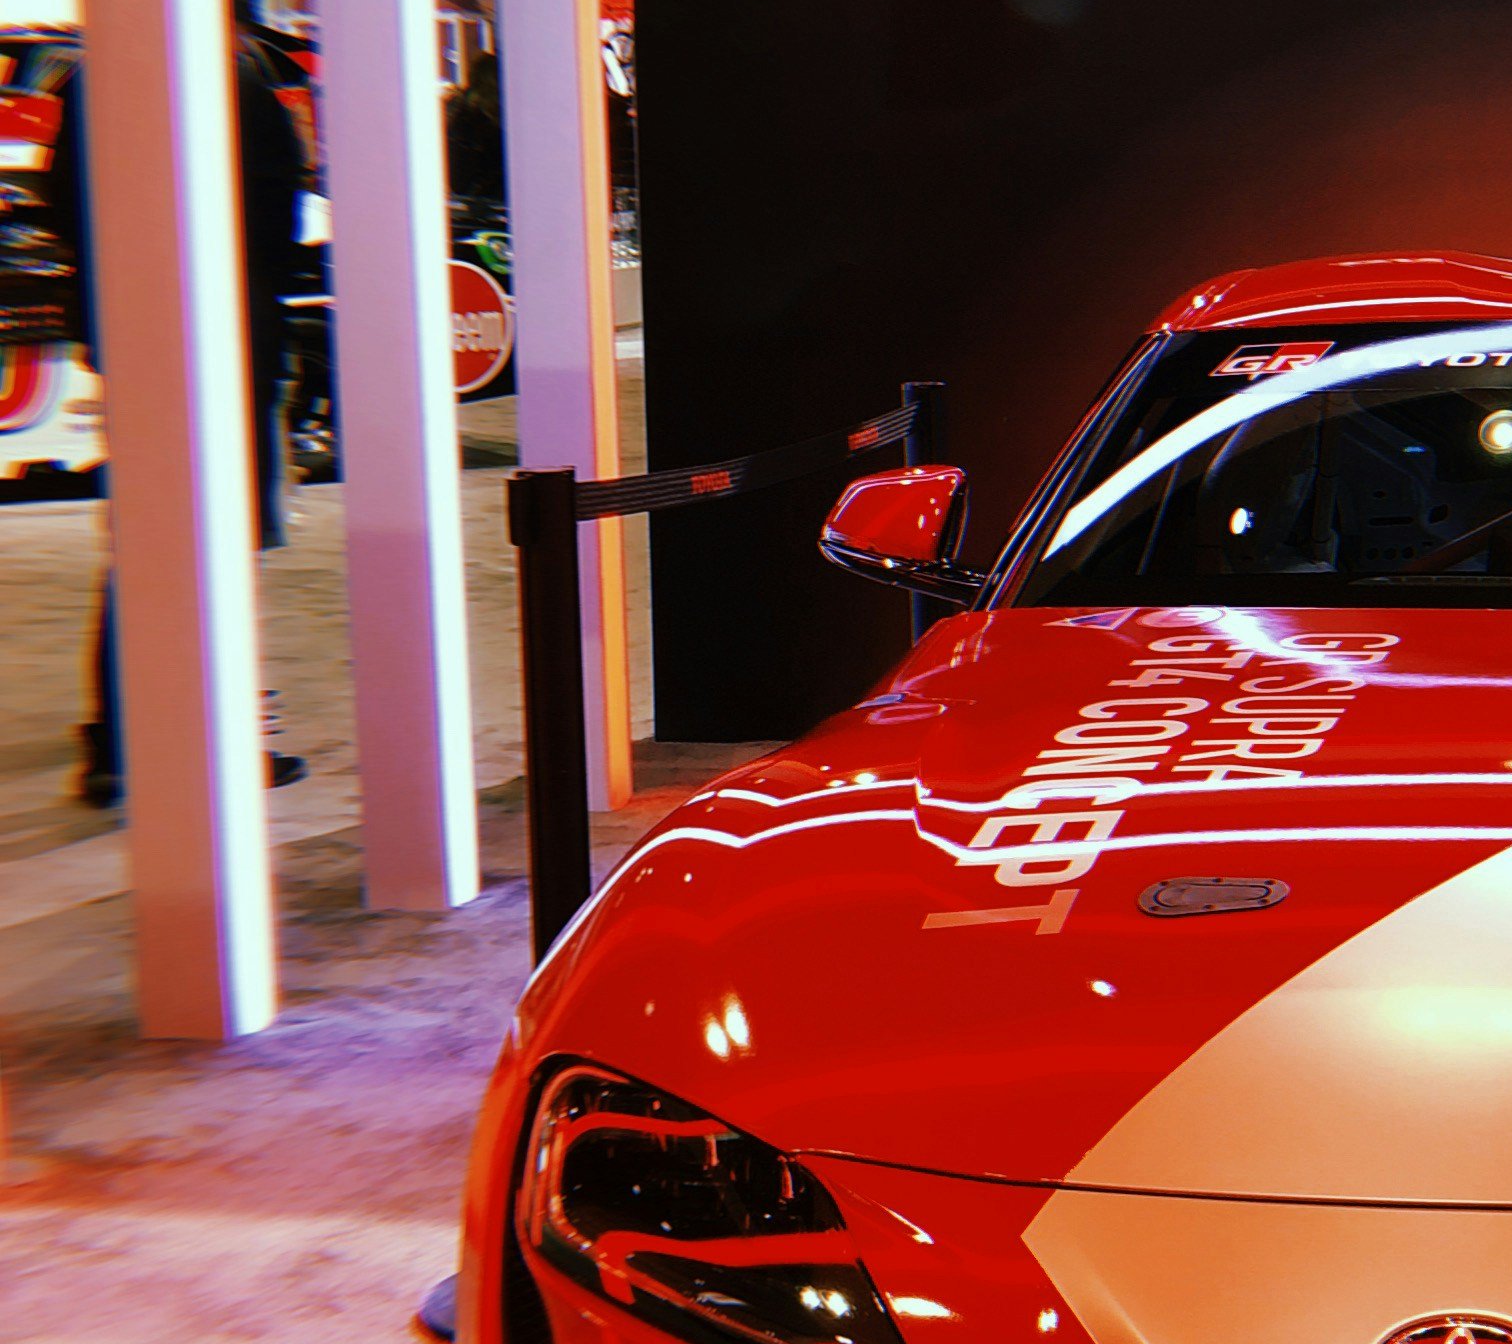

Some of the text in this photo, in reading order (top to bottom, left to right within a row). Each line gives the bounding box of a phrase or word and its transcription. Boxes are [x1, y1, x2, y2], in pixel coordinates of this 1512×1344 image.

[921, 634, 1255, 936] GT4 CONCEPT
[1171, 675, 1368, 788] SUPRA
